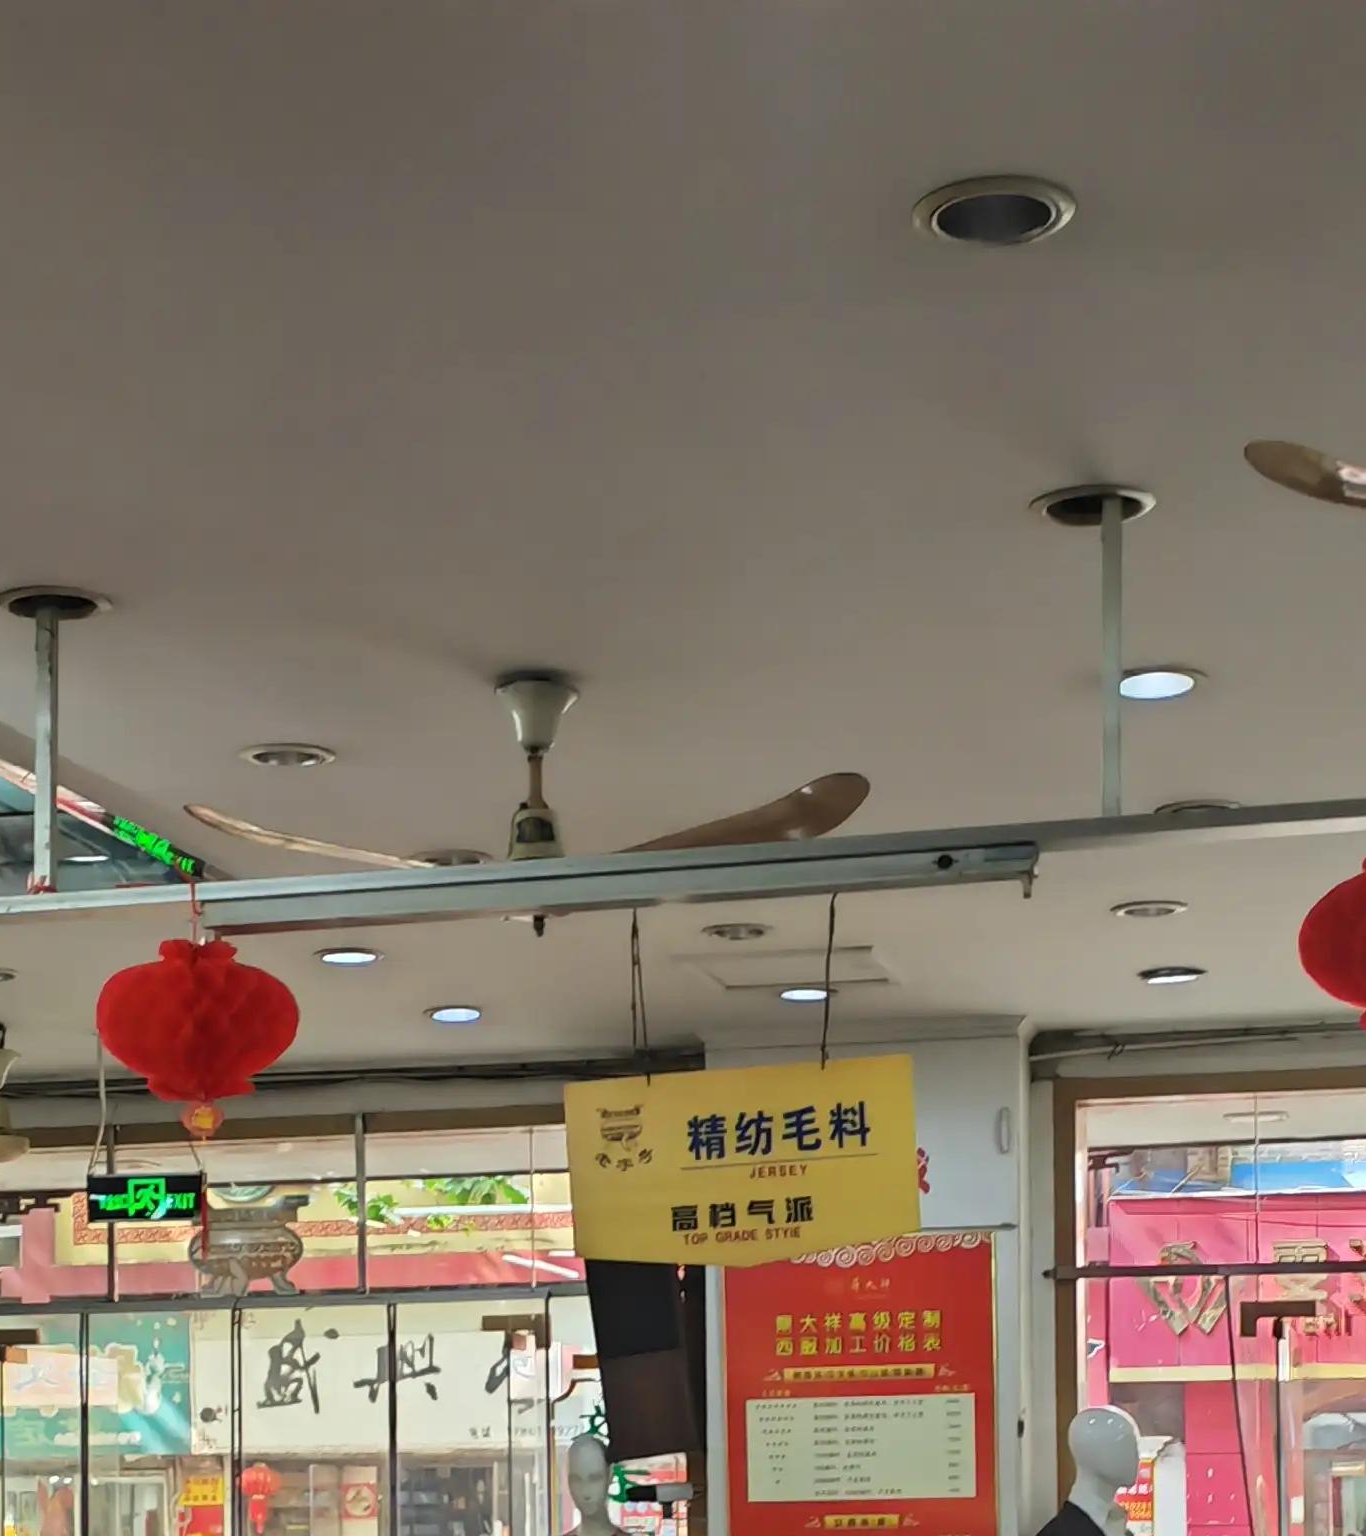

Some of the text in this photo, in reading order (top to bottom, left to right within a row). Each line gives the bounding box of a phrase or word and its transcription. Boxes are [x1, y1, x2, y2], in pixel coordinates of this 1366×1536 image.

[687, 1101, 871, 1161] 精纺毛料
[749, 1164, 808, 1180] JERSEY
[671, 1195, 815, 1233] 高档气派
[683, 1232, 709, 1246] TOP
[715, 1228, 759, 1244] GRADE
